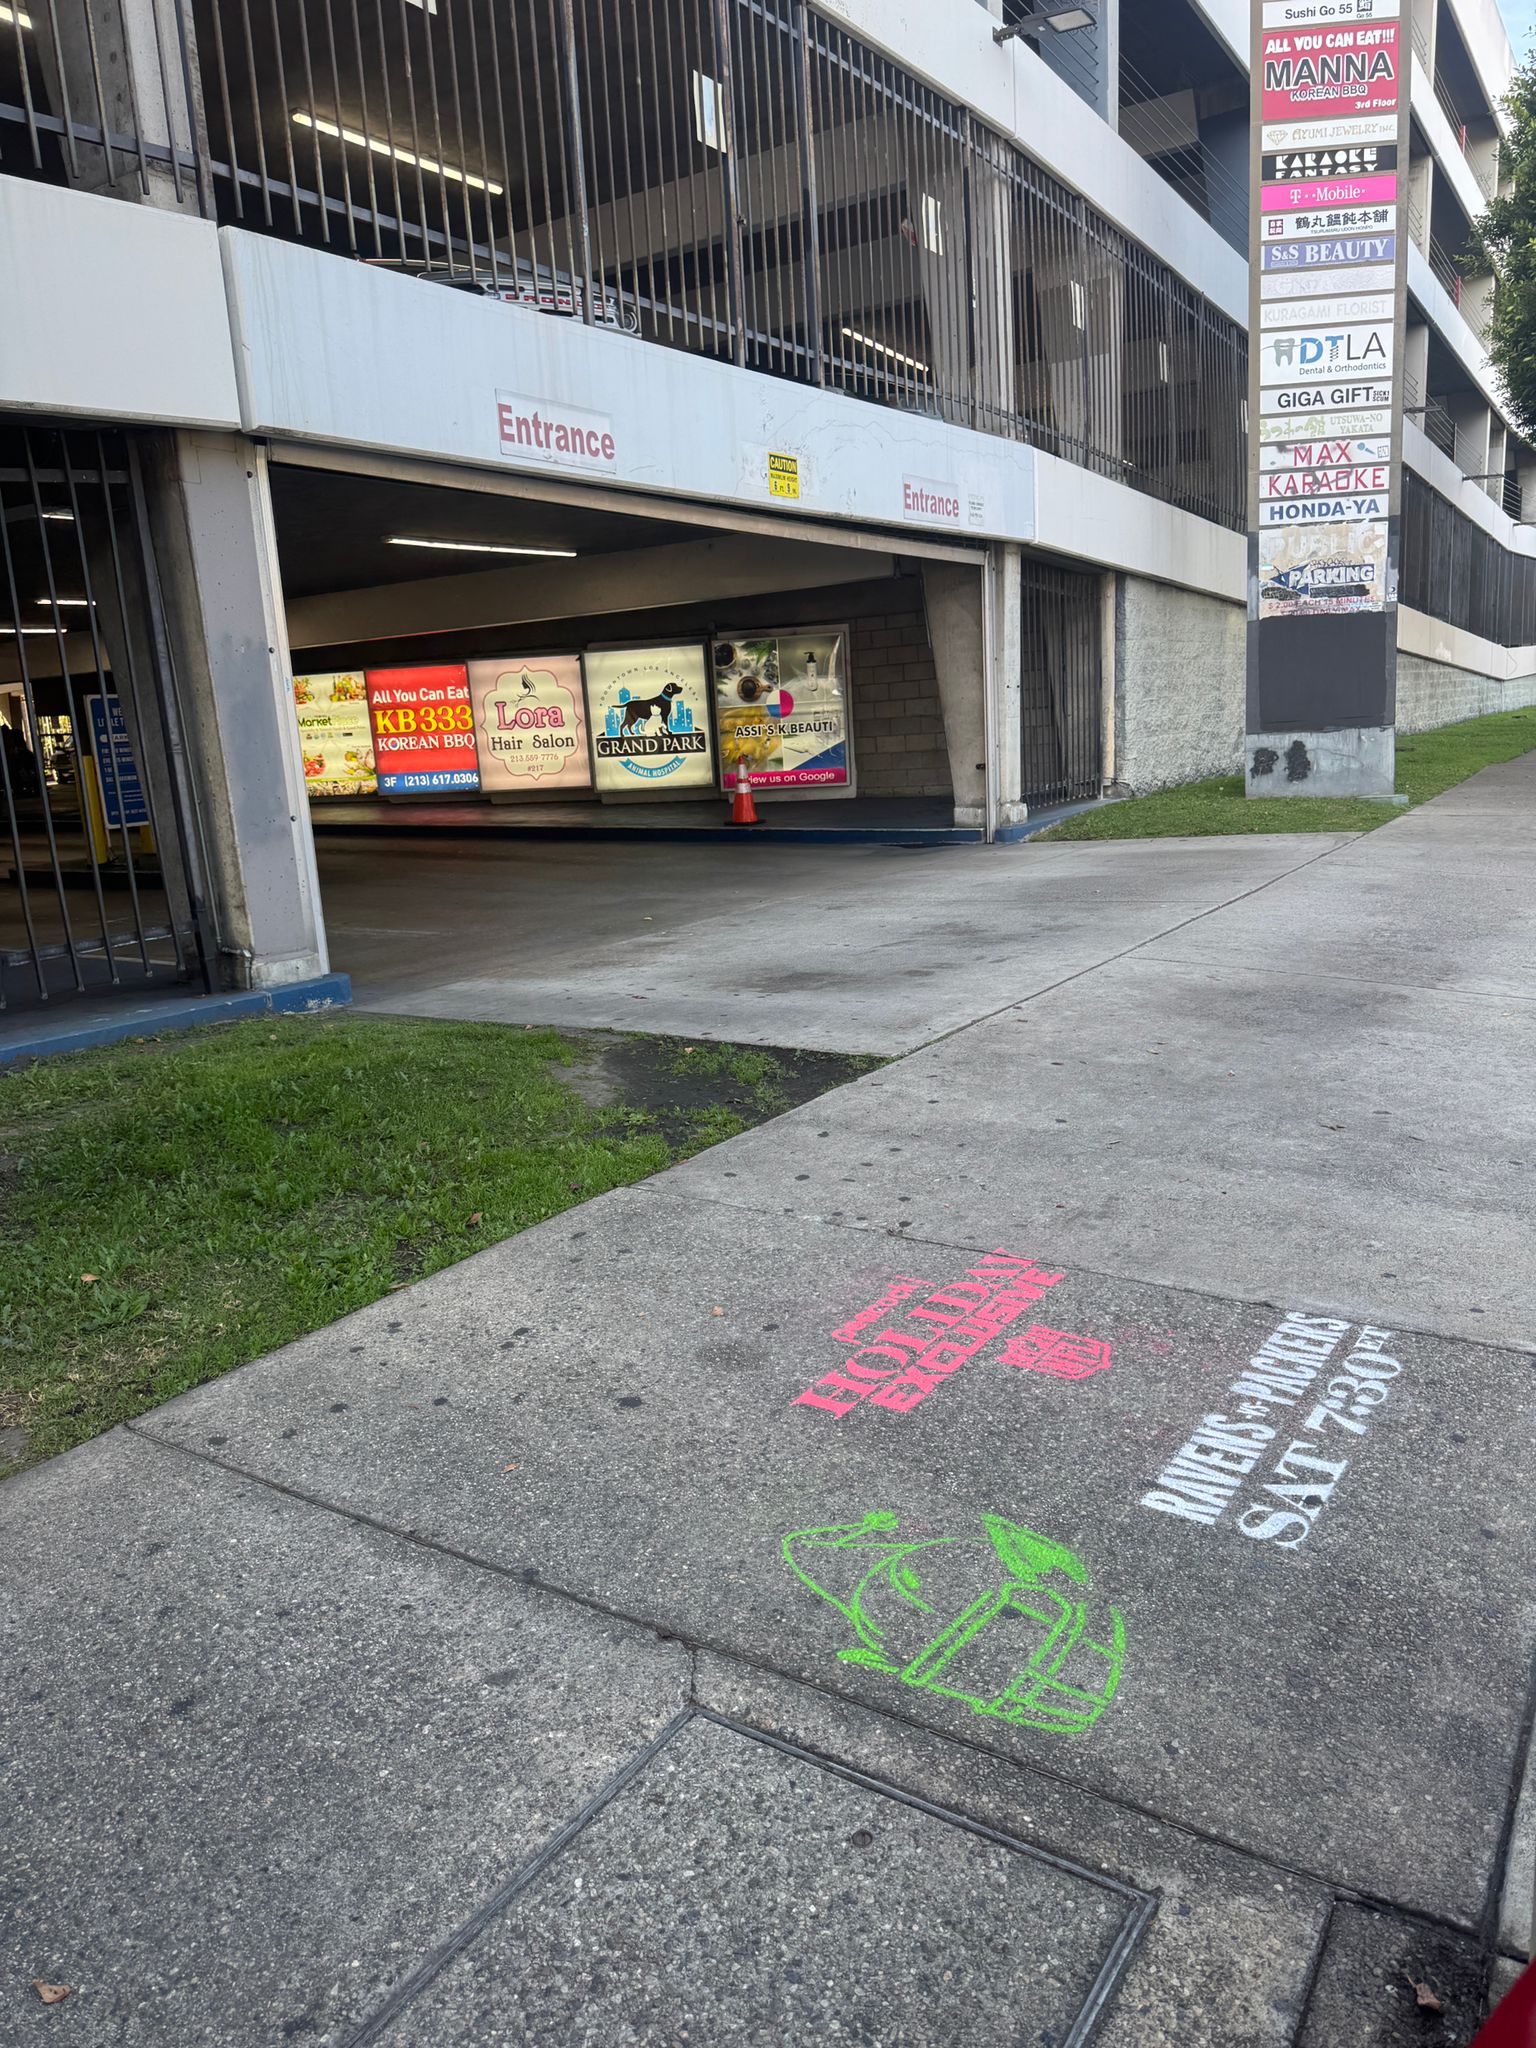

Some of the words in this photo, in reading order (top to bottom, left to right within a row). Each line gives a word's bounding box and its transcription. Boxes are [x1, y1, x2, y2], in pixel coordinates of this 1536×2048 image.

[1285, 6, 1316, 20] Sushi
[1319, 5, 1335, 16] Go
[1338, 3, 1353, 14] 55
[1264, 38, 1291, 55] ALL
[1294, 35, 1323, 50] YOU
[1325, 32, 1354, 49] CAN
[1356, 28, 1396, 45] EAT!!!
[1264, 51, 1395, 91] MANNA
[1291, 86, 1340, 102] KOREAN
[1342, 83, 1368, 96] BBQ
[1355, 100, 1370, 109] 3rd
[1373, 98, 1396, 108] Floor
[1329, 123, 1378, 138] JEWELRY
[1276, 147, 1377, 170] KARAOKE
[1276, 162, 1378, 180] FANTASY
[1271, 244, 1299, 261] S&S
[1305, 238, 1390, 263] BEAUTY
[1264, 305, 1330, 322] KURAGAMI
[1337, 300, 1387, 317] FLORIST
[1299, 331, 1387, 364] DTLA
[1299, 365, 1325, 375] Dental
[1327, 364, 1333, 373] &
[1335, 362, 1386, 373] Orthodontics
[1277, 391, 1325, 408] GIGA
[1331, 386, 1374, 404] GIFT
[1330, 412, 1383, 426] UTSUWA-NO
[1340, 424, 1374, 435] YAKATA
[497, 402, 616, 460] Entrance
[770, 456, 797, 473] CAUTION
[1293, 441, 1352, 467] MAX
[1268, 467, 1386, 496] KARAOKE
[903, 483, 959, 517] Entrance
[1270, 498, 1380, 521] HONDA-YA
[1288, 565, 1374, 590] PARKING
[372, 690, 392, 704] All
[393, 689, 417, 703] You
[419, 687, 444, 701] Can
[446, 686, 470, 700] Eat
[297, 716, 333, 727] Market
[374, 708, 417, 734] KB
[420, 705, 474, 732] 333
[494, 701, 565, 731] Lora
[378, 735, 440, 752] KOREAN
[443, 733, 476, 750] BBQ
[491, 735, 524, 751] Hair
[532, 733, 575, 749] Salon
[597, 738, 658, 755] GRAND
[662, 735, 704, 752] PARK
[384, 777, 397, 787] 3F
[404, 774, 430, 787] (213)
[432, 772, 479, 785] 617.0306
[628, 763, 651, 777] ANIMAL
[652, 760, 681, 777] HOSPITAL
[769, 775, 782, 783] us
[799, 771, 835, 782] Google
[791, 1247, 1039, 1420] HOLIDAY
[870, 1268, 1067, 1413] EXCLUSIVE
[1139, 1412, 1277, 1525] RAVENS
[1230, 1310, 1351, 1406] PACKERS
[1238, 1440, 1349, 1551] SAT
[1304, 1351, 1402, 1435] 7:30
[1354, 1324, 1396, 1351] ET
